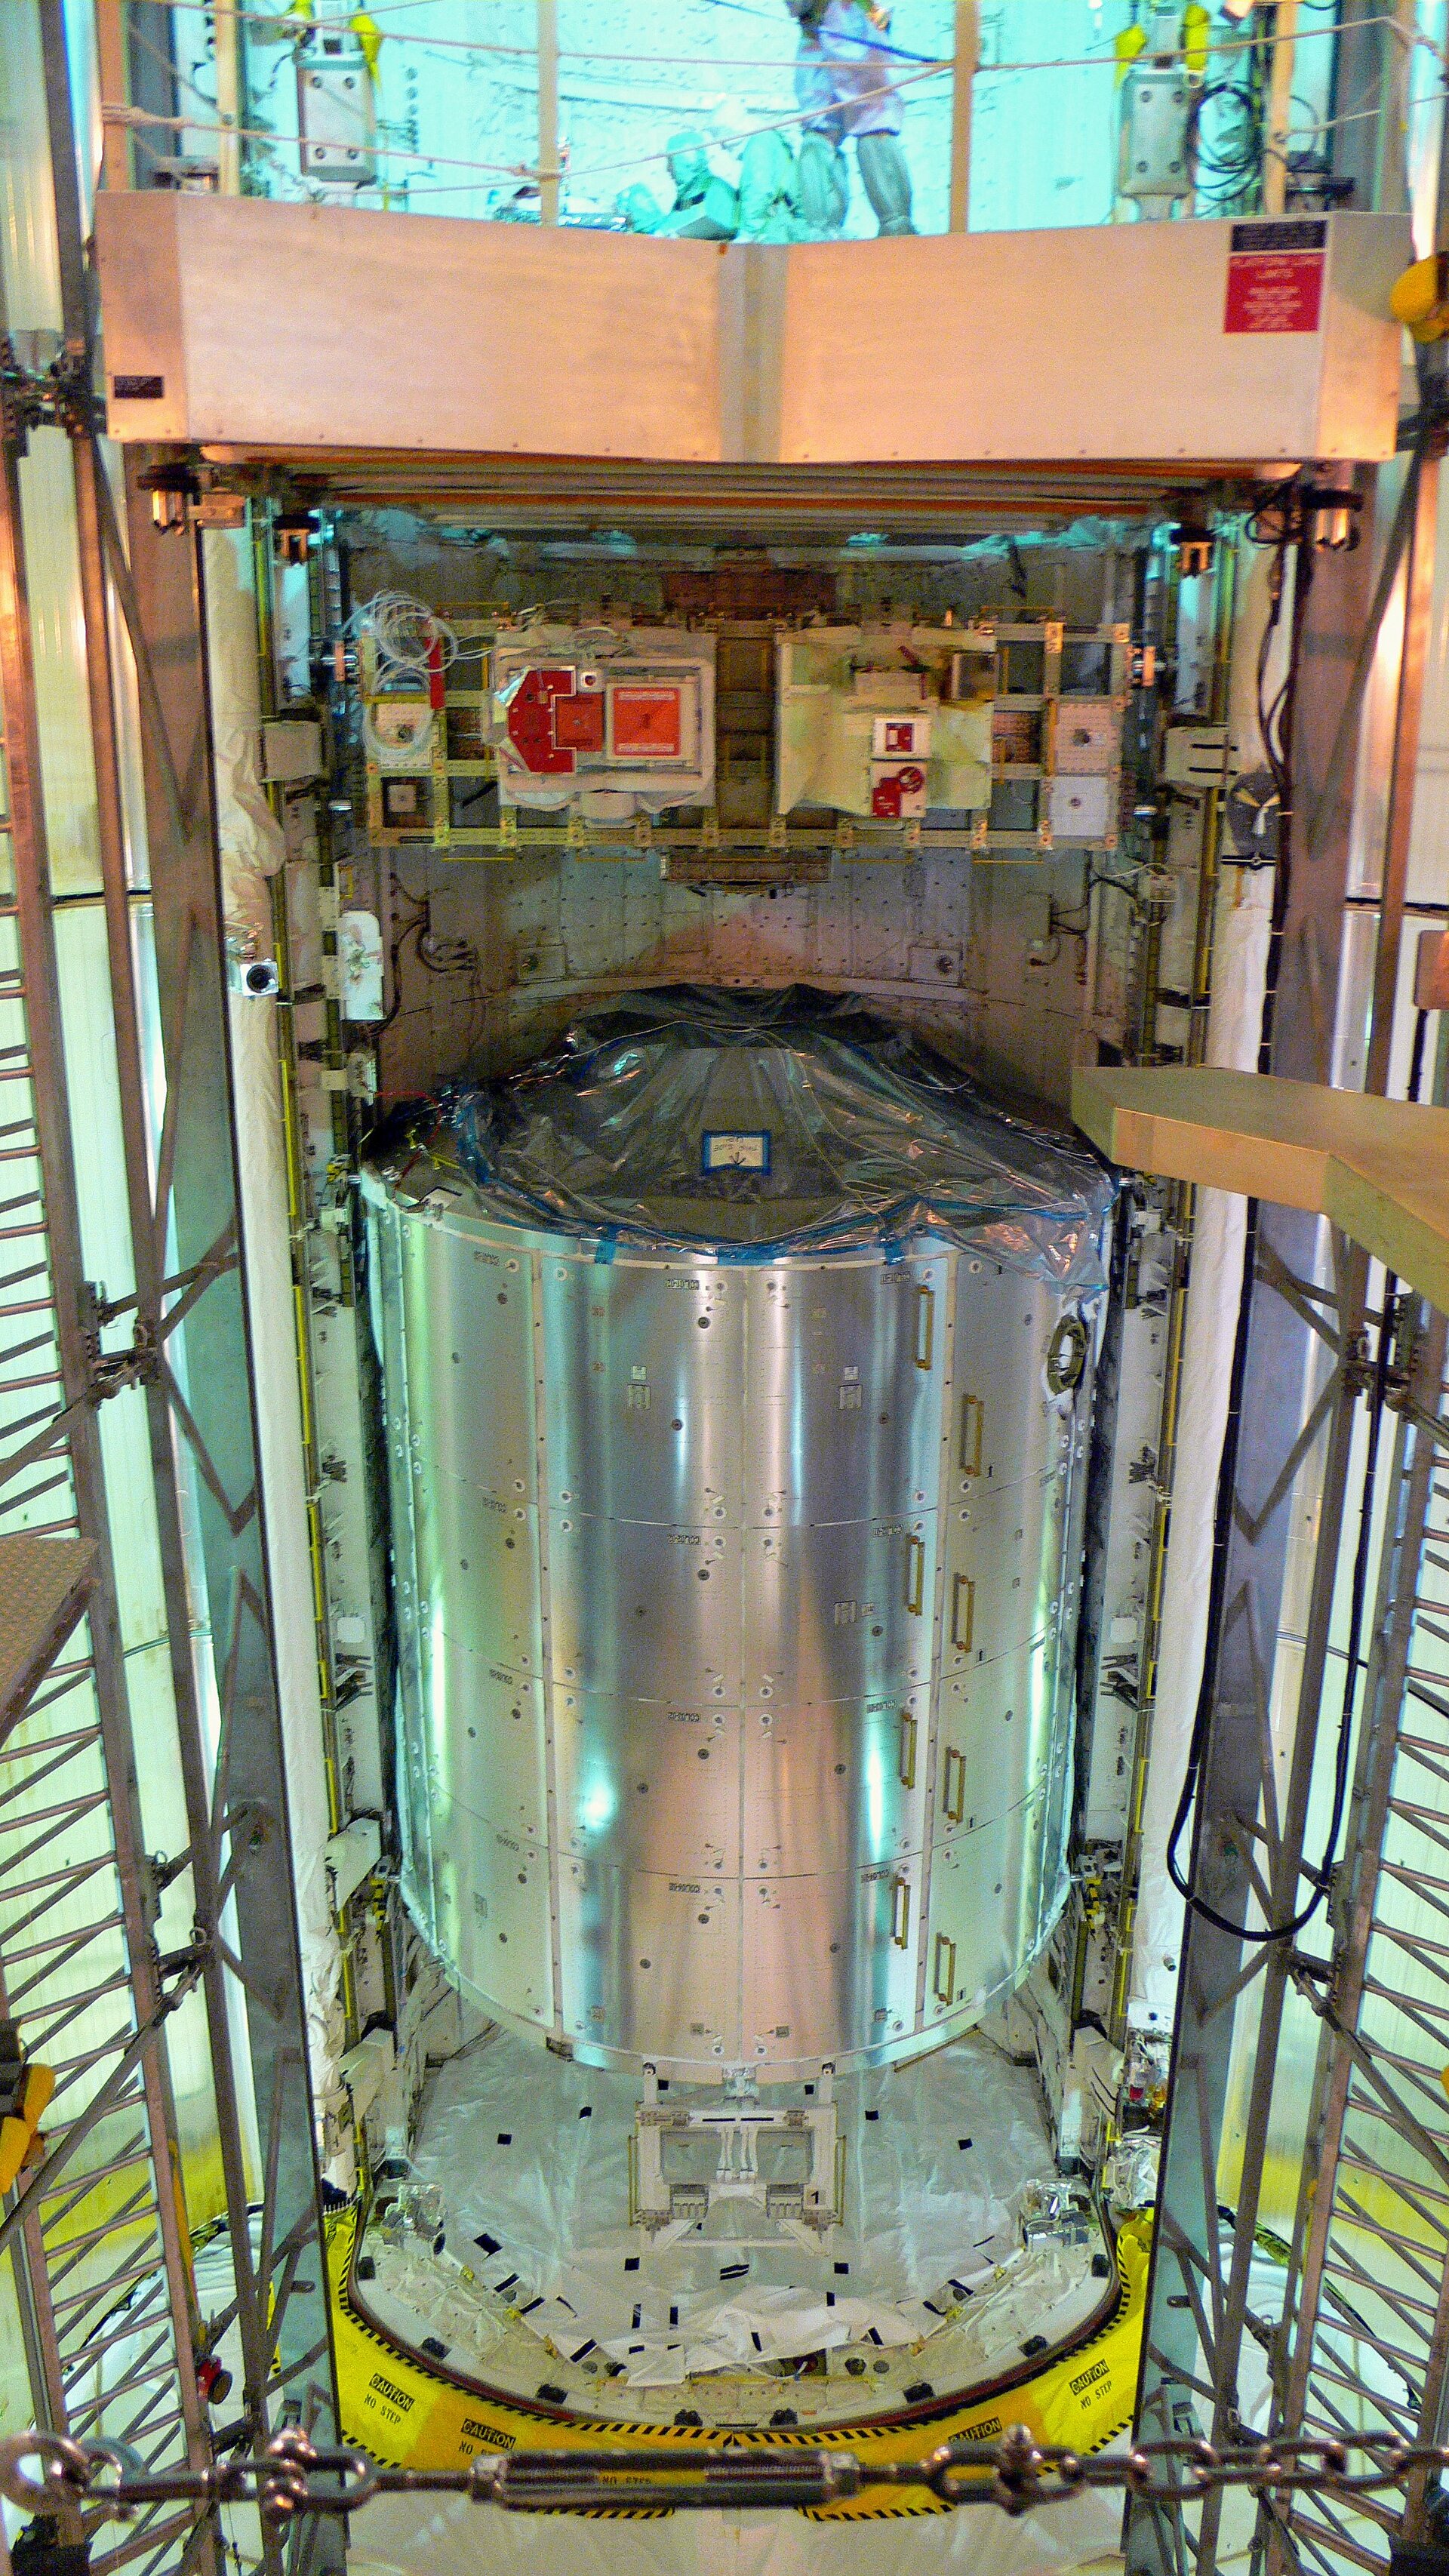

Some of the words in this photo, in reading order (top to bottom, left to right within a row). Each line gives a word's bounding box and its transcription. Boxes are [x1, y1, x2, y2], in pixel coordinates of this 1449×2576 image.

[1071, 2359, 1109, 2394] CAUTION
[370, 2374, 414, 2411] CAUTION
[1080, 2395, 1091, 2410] NO
[1095, 2381, 1112, 2400] STEP
[364, 2393, 377, 2408] NO
[380, 2405, 401, 2425] STEP
[459, 2440, 473, 2454] NO
[462, 2420, 515, 2449] CAUTION
